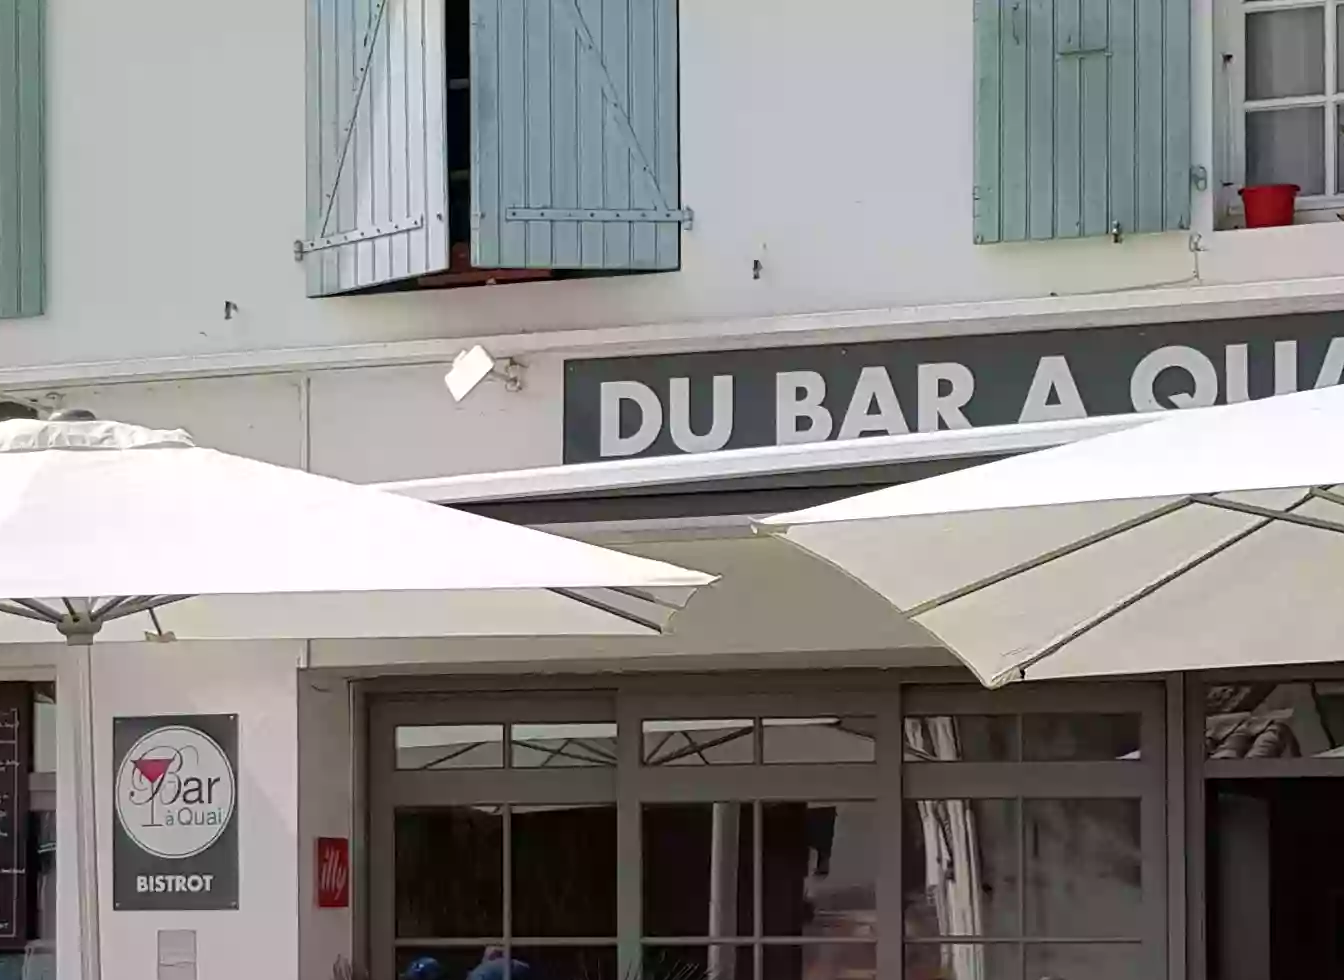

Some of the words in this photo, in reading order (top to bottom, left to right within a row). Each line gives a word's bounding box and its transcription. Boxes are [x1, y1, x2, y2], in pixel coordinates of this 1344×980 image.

[600, 375, 733, 457] DU
[776, 362, 975, 446] BAR
[1018, 355, 1088, 424] A
[129, 745, 221, 805] Bar
[177, 806, 223, 826] Quai
[136, 875, 214, 893] BISTROT
[320, 848, 347, 901] illy
